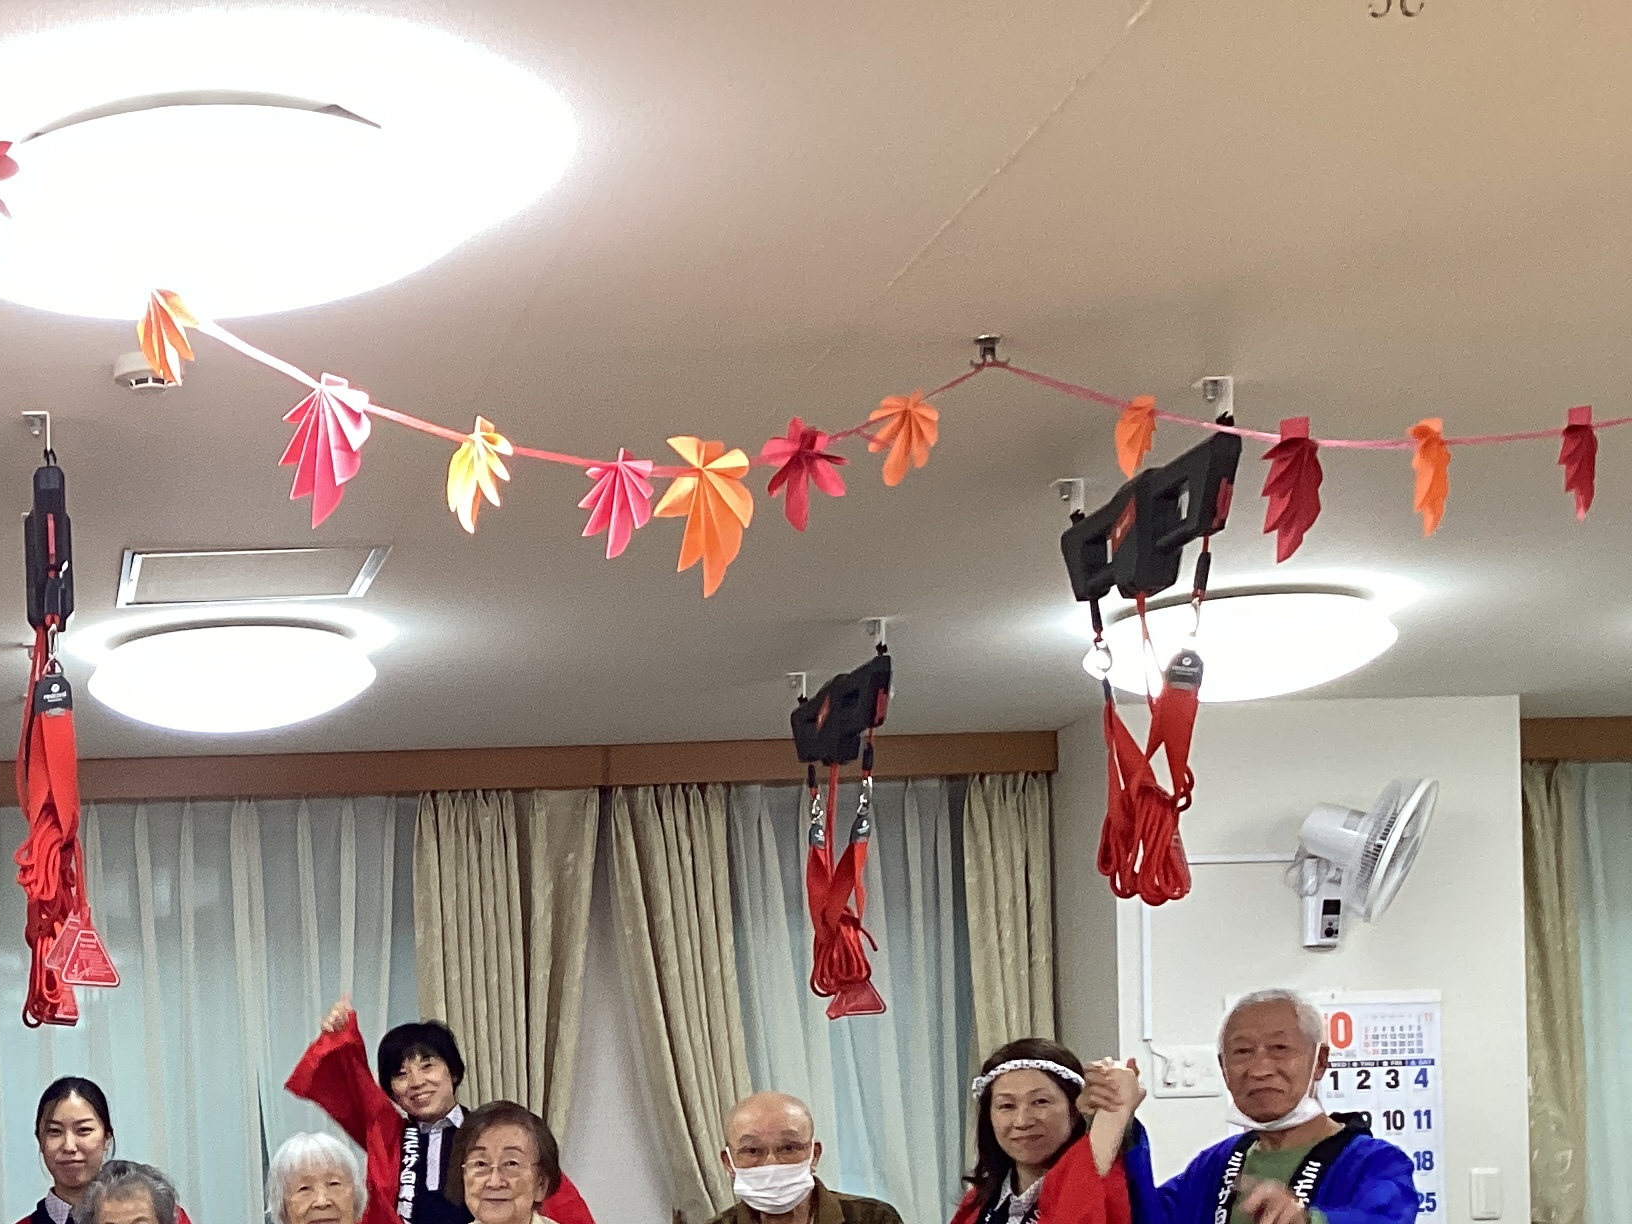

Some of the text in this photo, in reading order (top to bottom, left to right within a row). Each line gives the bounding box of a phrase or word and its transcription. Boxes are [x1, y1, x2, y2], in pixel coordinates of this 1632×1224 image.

[1323, 1012, 1353, 1049] 0
[1330, 1067, 1428, 1090] 1 2 3 4
[1382, 1109, 1405, 1131] 10
[1413, 1109, 1432, 1130] 11
[1413, 1151, 1434, 1171] 18
[1418, 1192, 1437, 1212] 25
